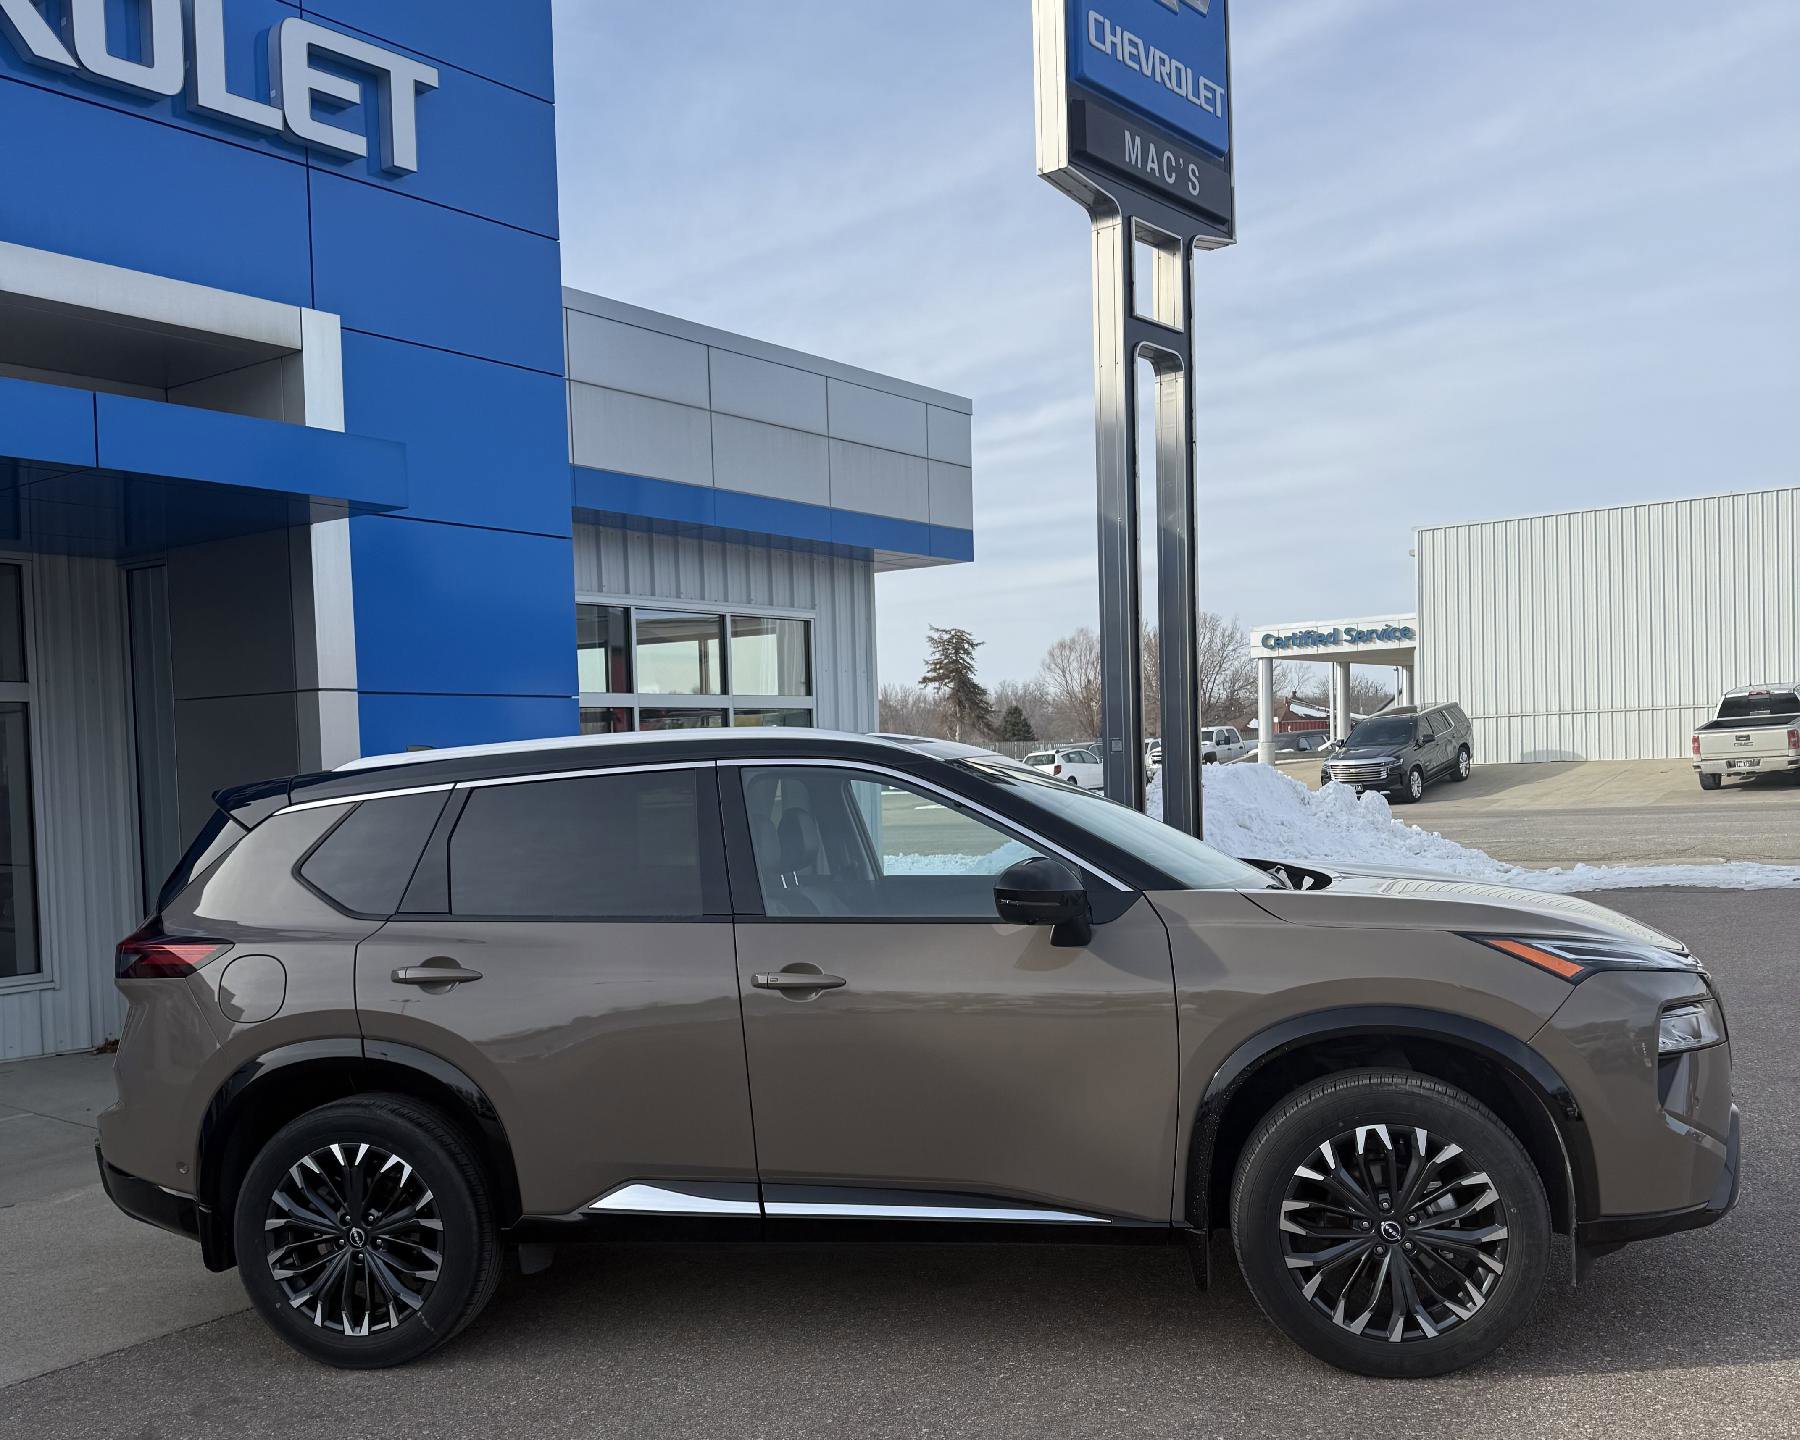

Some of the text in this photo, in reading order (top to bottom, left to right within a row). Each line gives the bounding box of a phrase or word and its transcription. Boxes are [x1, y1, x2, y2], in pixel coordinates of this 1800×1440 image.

[1088, 10, 1224, 118] CHEVROLET
[1124, 130, 1200, 196] MAC'S
[1261, 624, 1416, 650] Certified Service
